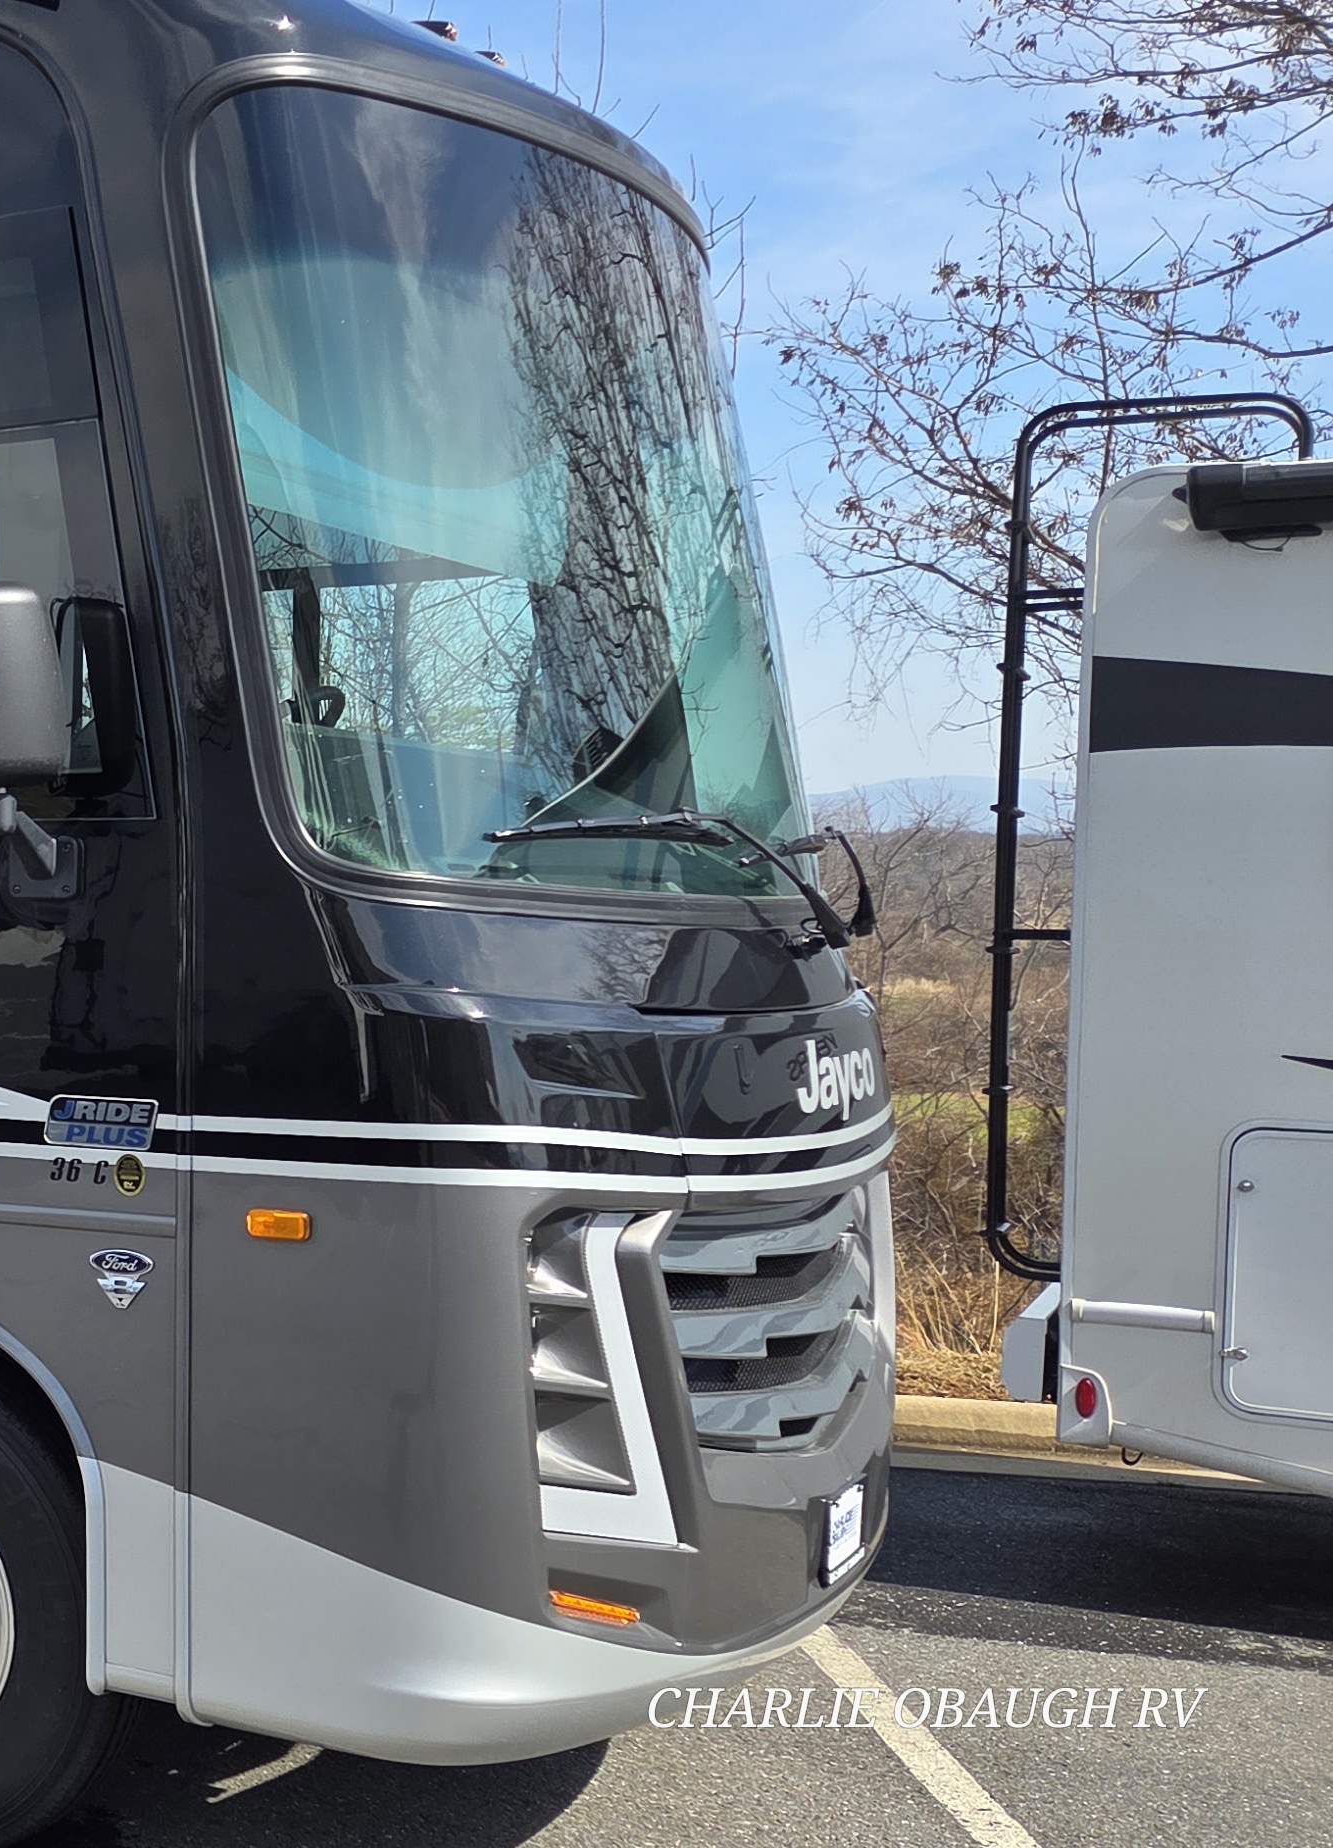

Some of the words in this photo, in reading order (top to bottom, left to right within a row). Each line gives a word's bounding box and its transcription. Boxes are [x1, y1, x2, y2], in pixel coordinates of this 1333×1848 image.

[796, 1039, 875, 1122] Jayco
[53, 1099, 152, 1124] JRIDE
[65, 1124, 148, 1147] PLUS
[50, 1157, 82, 1182] 36
[93, 1159, 110, 1185] C
[102, 1253, 139, 1272] Ford
